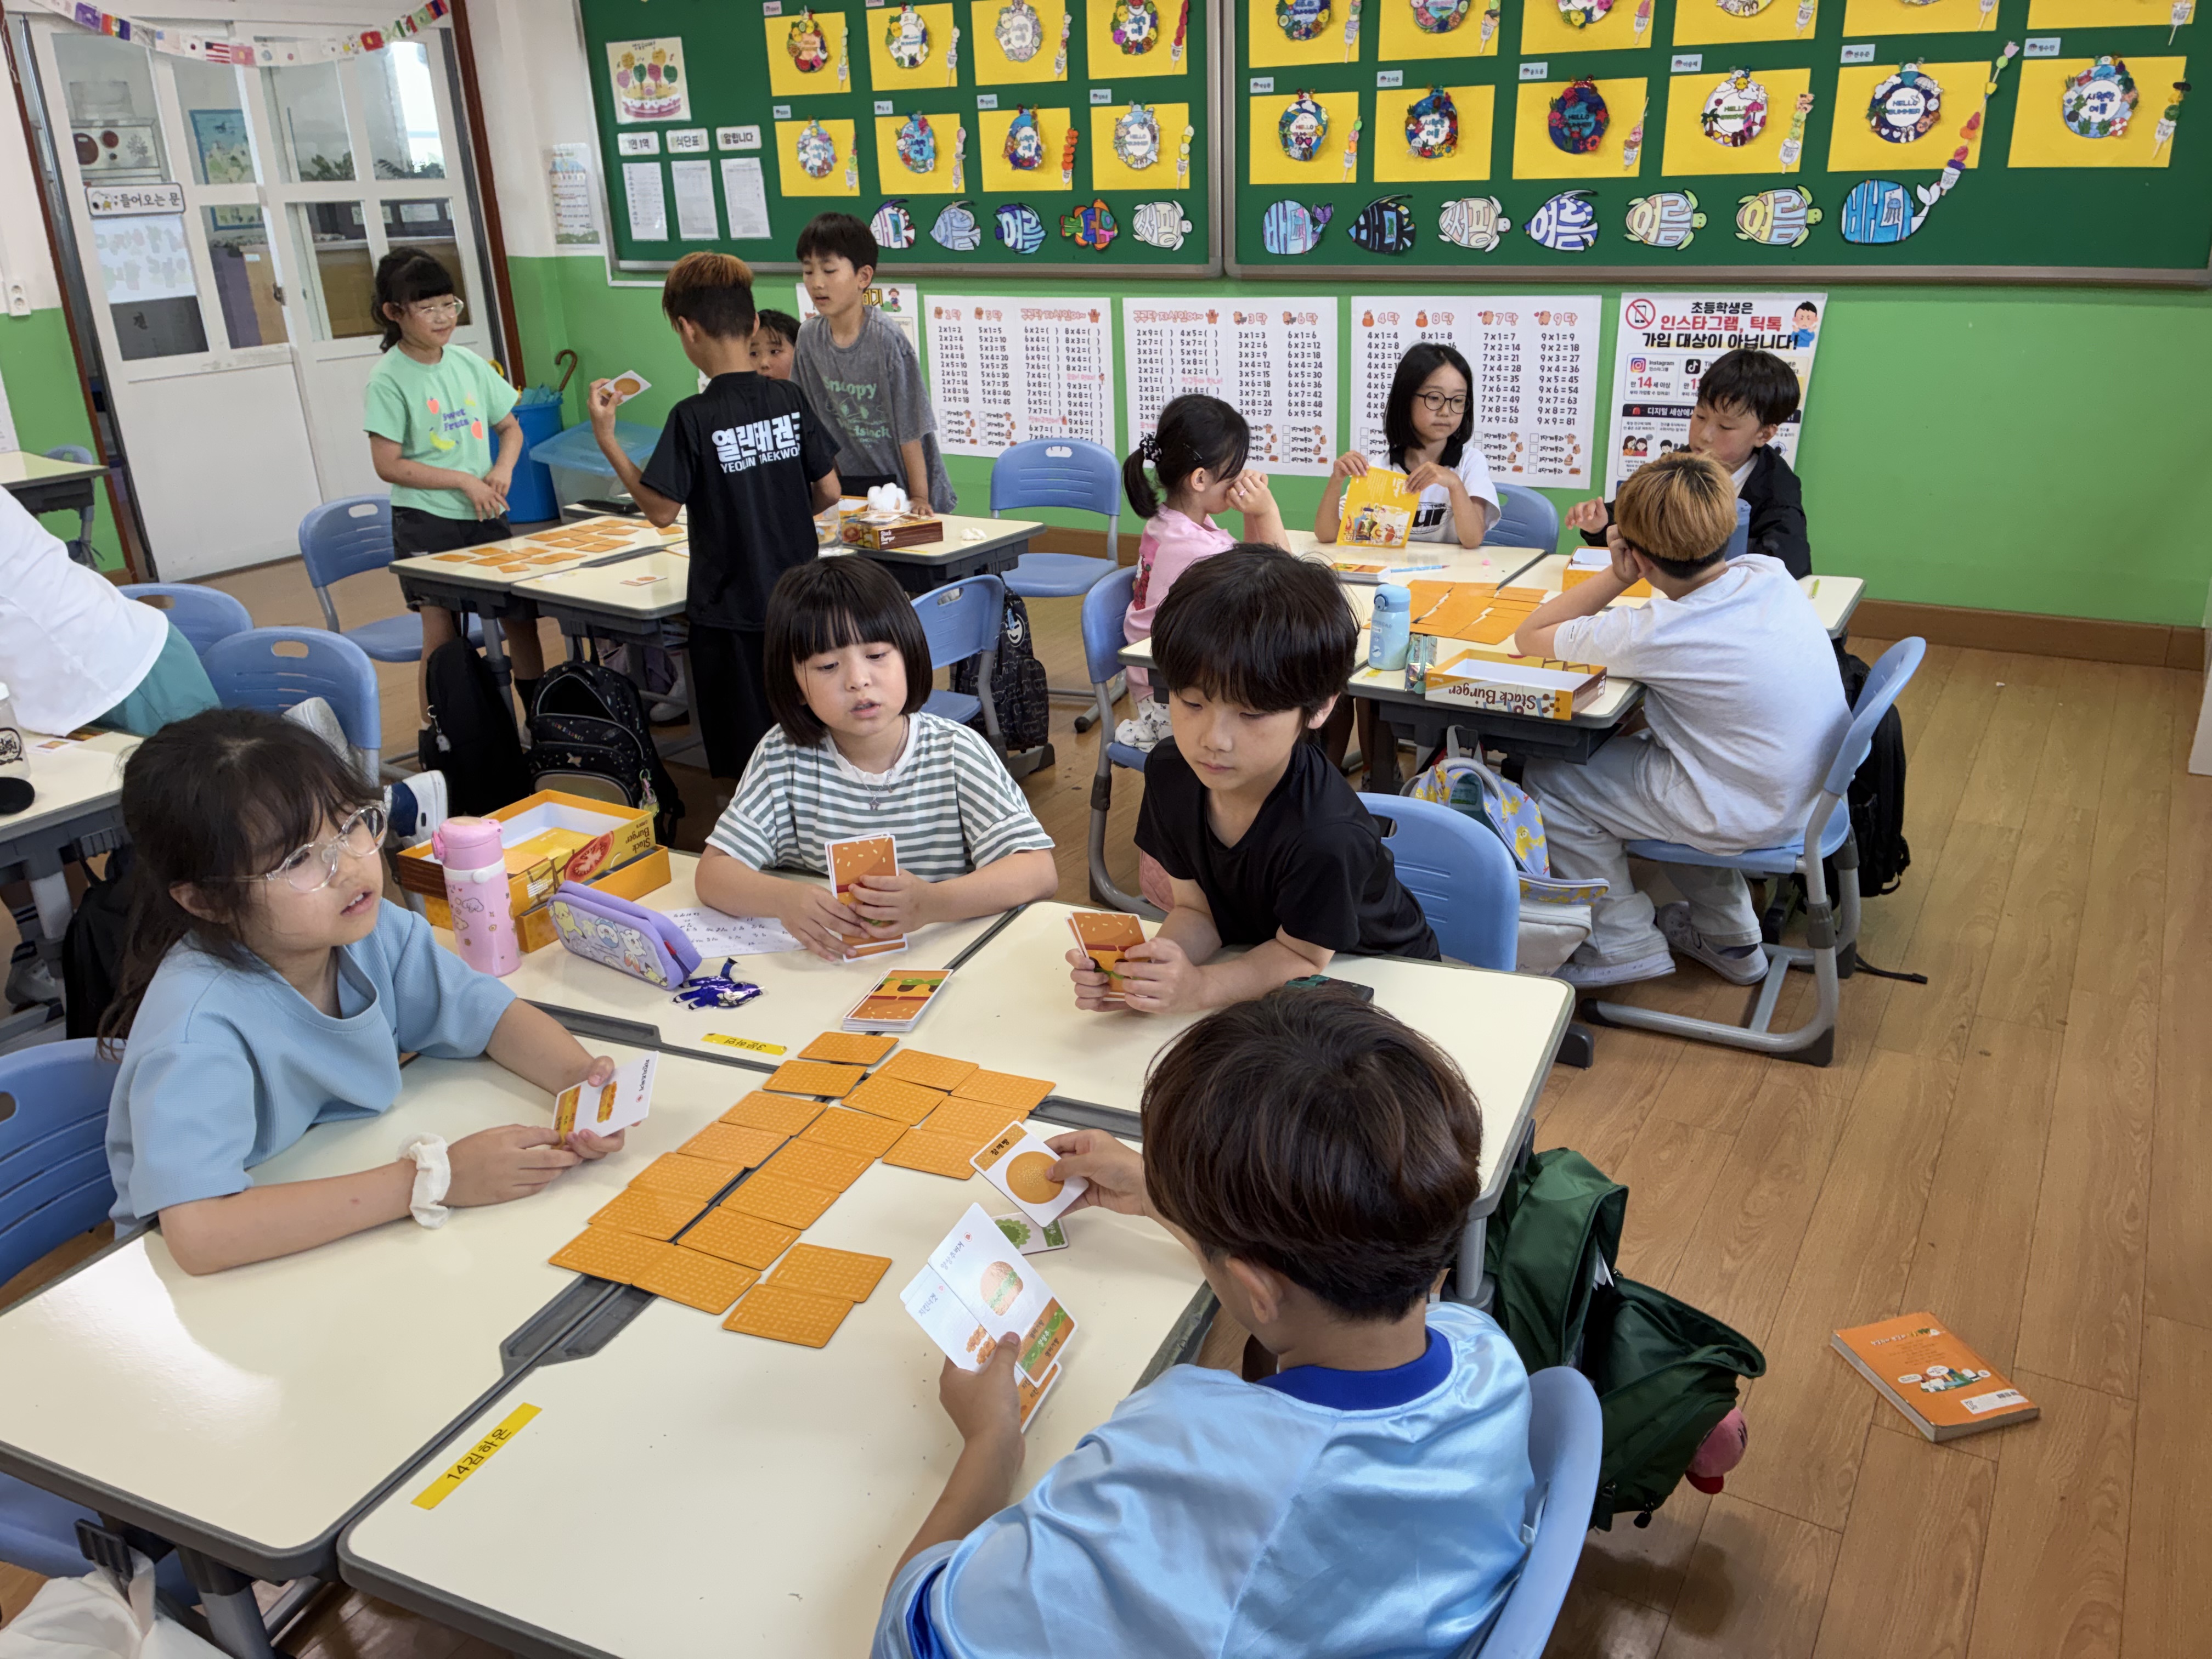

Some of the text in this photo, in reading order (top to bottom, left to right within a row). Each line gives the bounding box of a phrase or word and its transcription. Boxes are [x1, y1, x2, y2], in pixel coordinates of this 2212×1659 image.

[120, 193, 180, 208] 들어오는 문
[1691, 302, 1753, 314] 초등학생은
[1378, 312, 1400, 325] 4단
[1431, 312, 1455, 325] 8단
[1496, 312, 1519, 326] 7단
[1553, 312, 1578, 326] 9단
[1661, 315, 1782, 333] 인스타그램, 틱톡
[1643, 332, 1798, 350] 가입 대상이 아닙니다!
[443, 409, 466, 421] Sweet
[1647, 407, 1668, 416] 디지털
[444, 419, 469, 432] Fruits
[712, 411, 800, 462] 열린태권
[720, 443, 800, 474] YEOLIN TAEKWO
[1448, 682, 1536, 709] Stack Burger
[625, 827, 650, 844] Burger
[632, 838, 651, 854] Stack
[990, 1138, 1010, 1155] 참깨빵
[940, 1241, 964, 1270] 양상추버거
[918, 1293, 939, 1317] 치킨너겟
